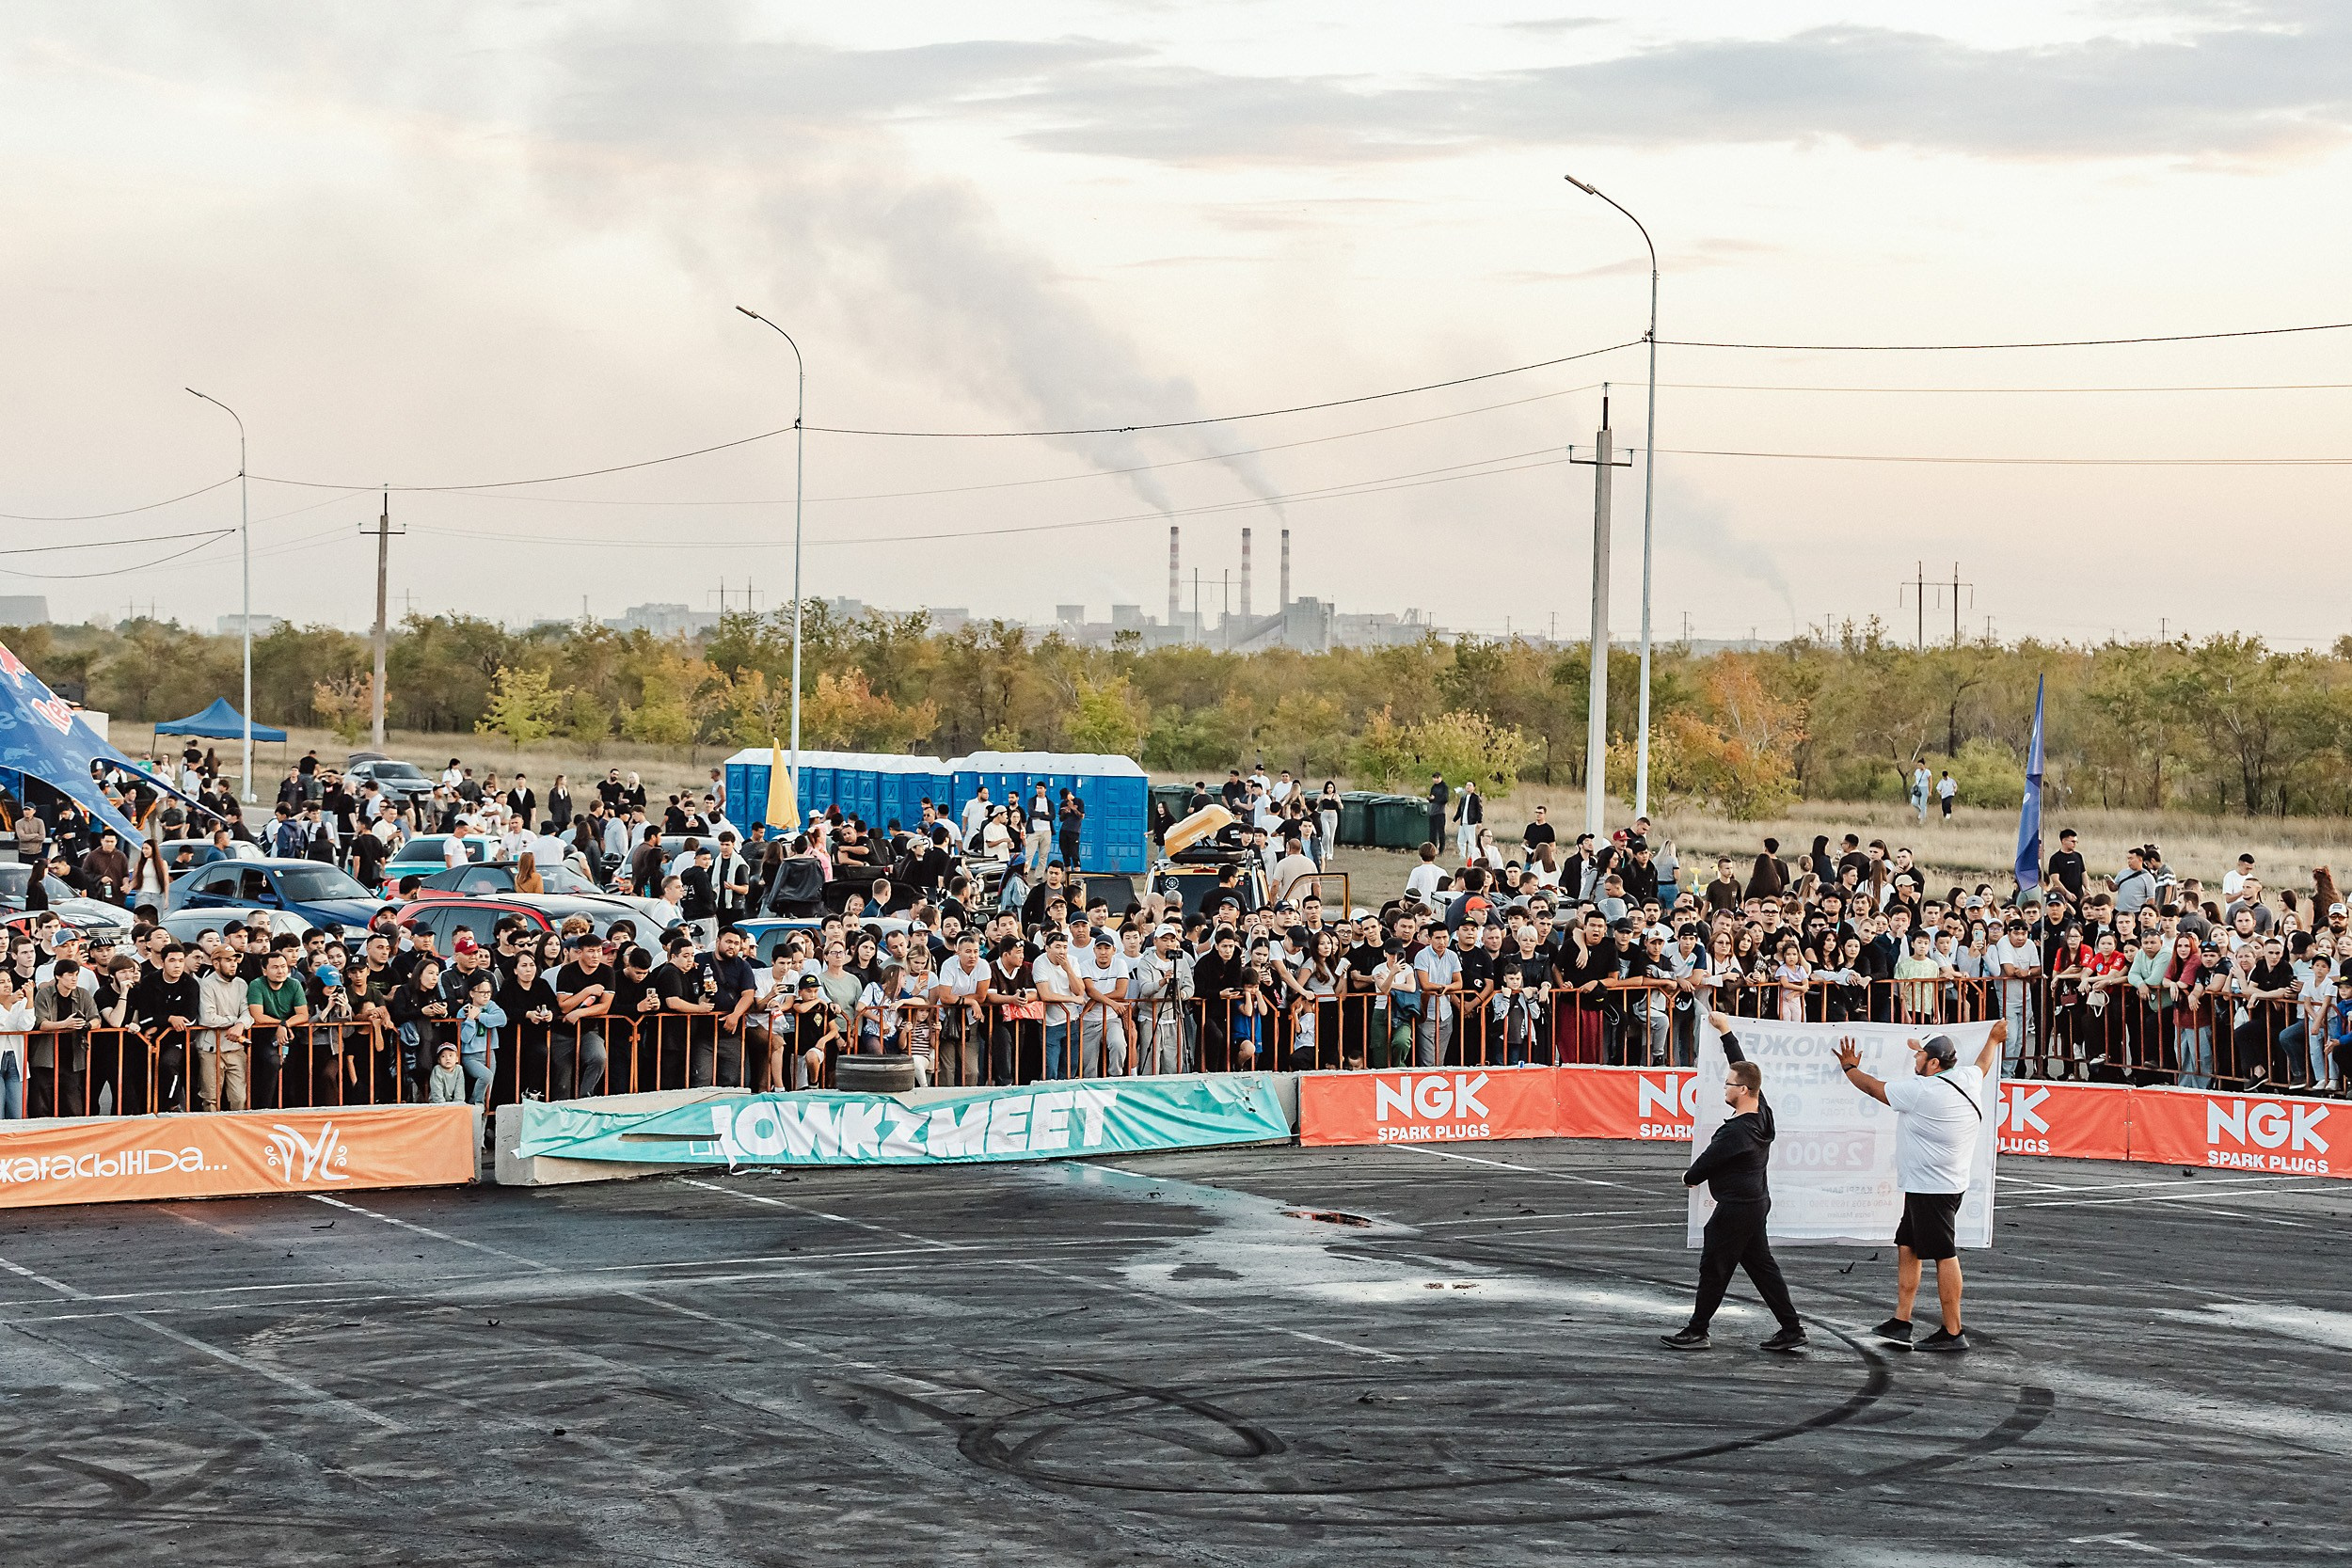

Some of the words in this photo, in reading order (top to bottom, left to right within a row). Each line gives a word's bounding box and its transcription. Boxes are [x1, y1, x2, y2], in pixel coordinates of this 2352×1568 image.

[1375, 1071, 1490, 1121] NGK
[1377, 1126, 1432, 1142] SPARK
[1435, 1123, 1490, 1139] PLUGS
[2207, 1098, 2330, 1155] NGK
[1996, 1136, 2050, 1153] LUGS
[2207, 1150, 2265, 1169] SPARK
[2269, 1155, 2329, 1174] PLUGS
